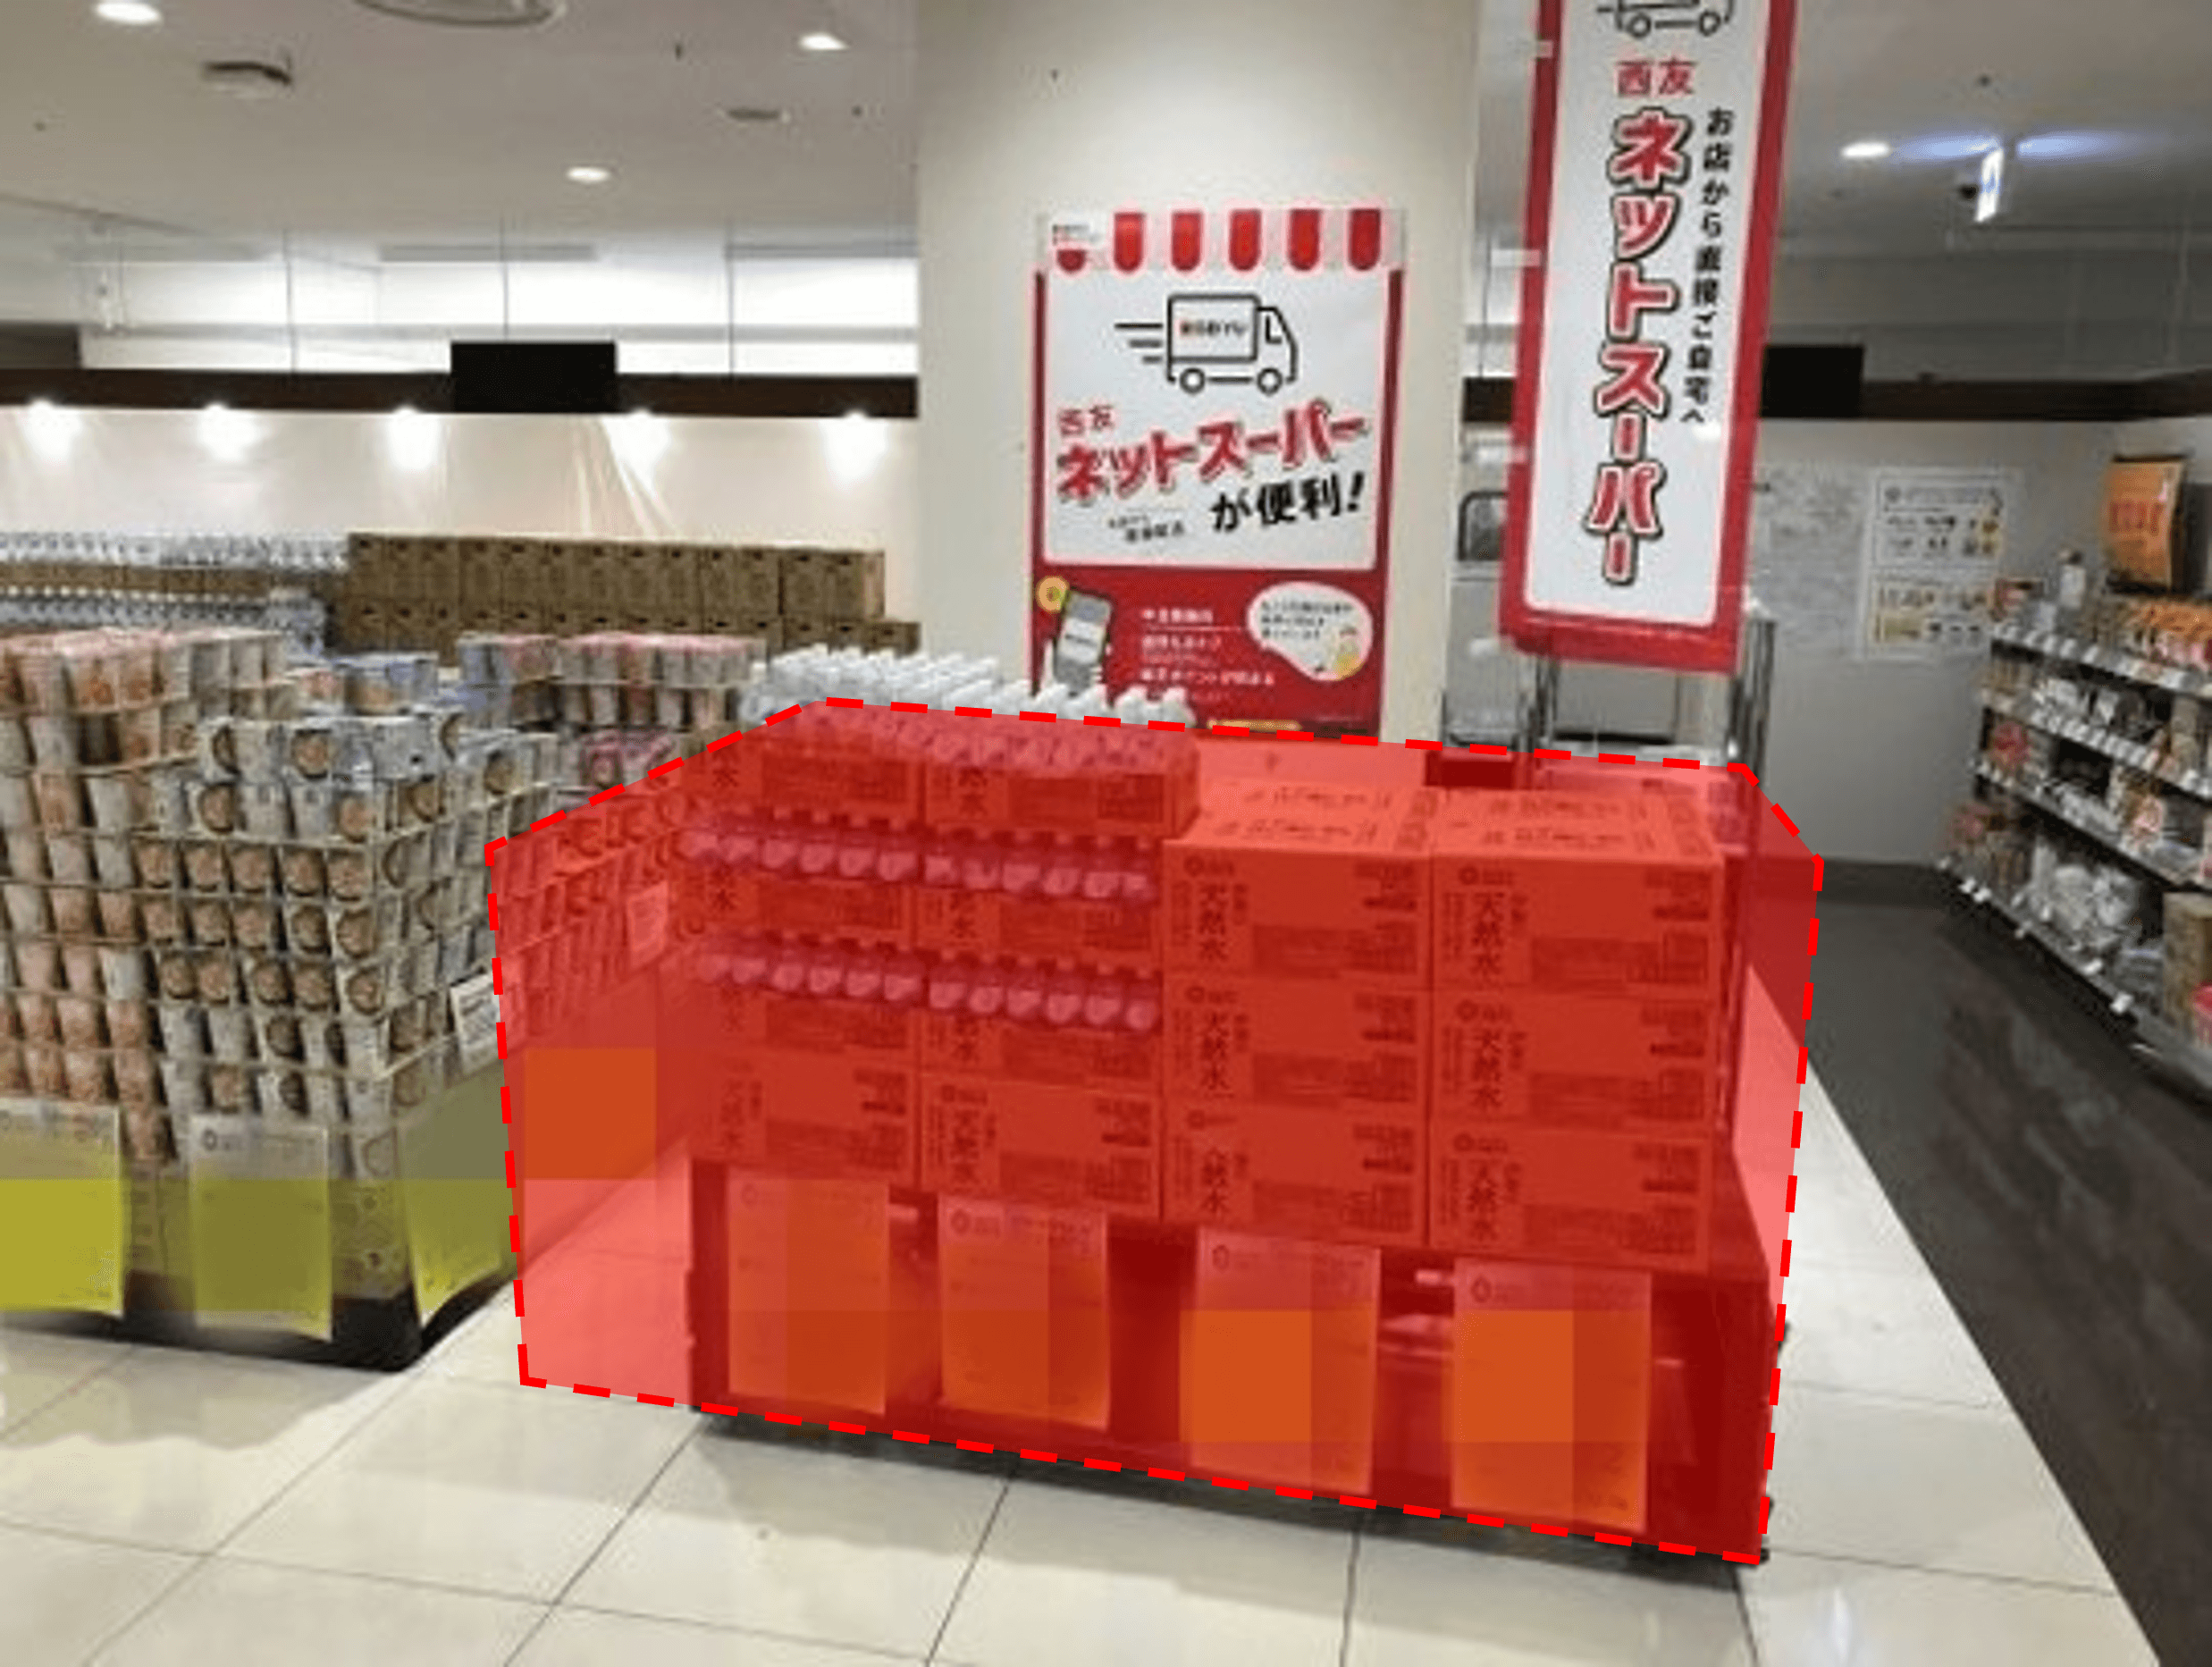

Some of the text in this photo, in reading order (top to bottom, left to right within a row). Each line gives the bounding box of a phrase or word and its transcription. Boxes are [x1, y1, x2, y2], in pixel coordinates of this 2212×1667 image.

[1616, 57, 1696, 97] 西友
[1585, 105, 1693, 586] ネットスーパー
[1057, 399, 1370, 506] ネットスーパー
